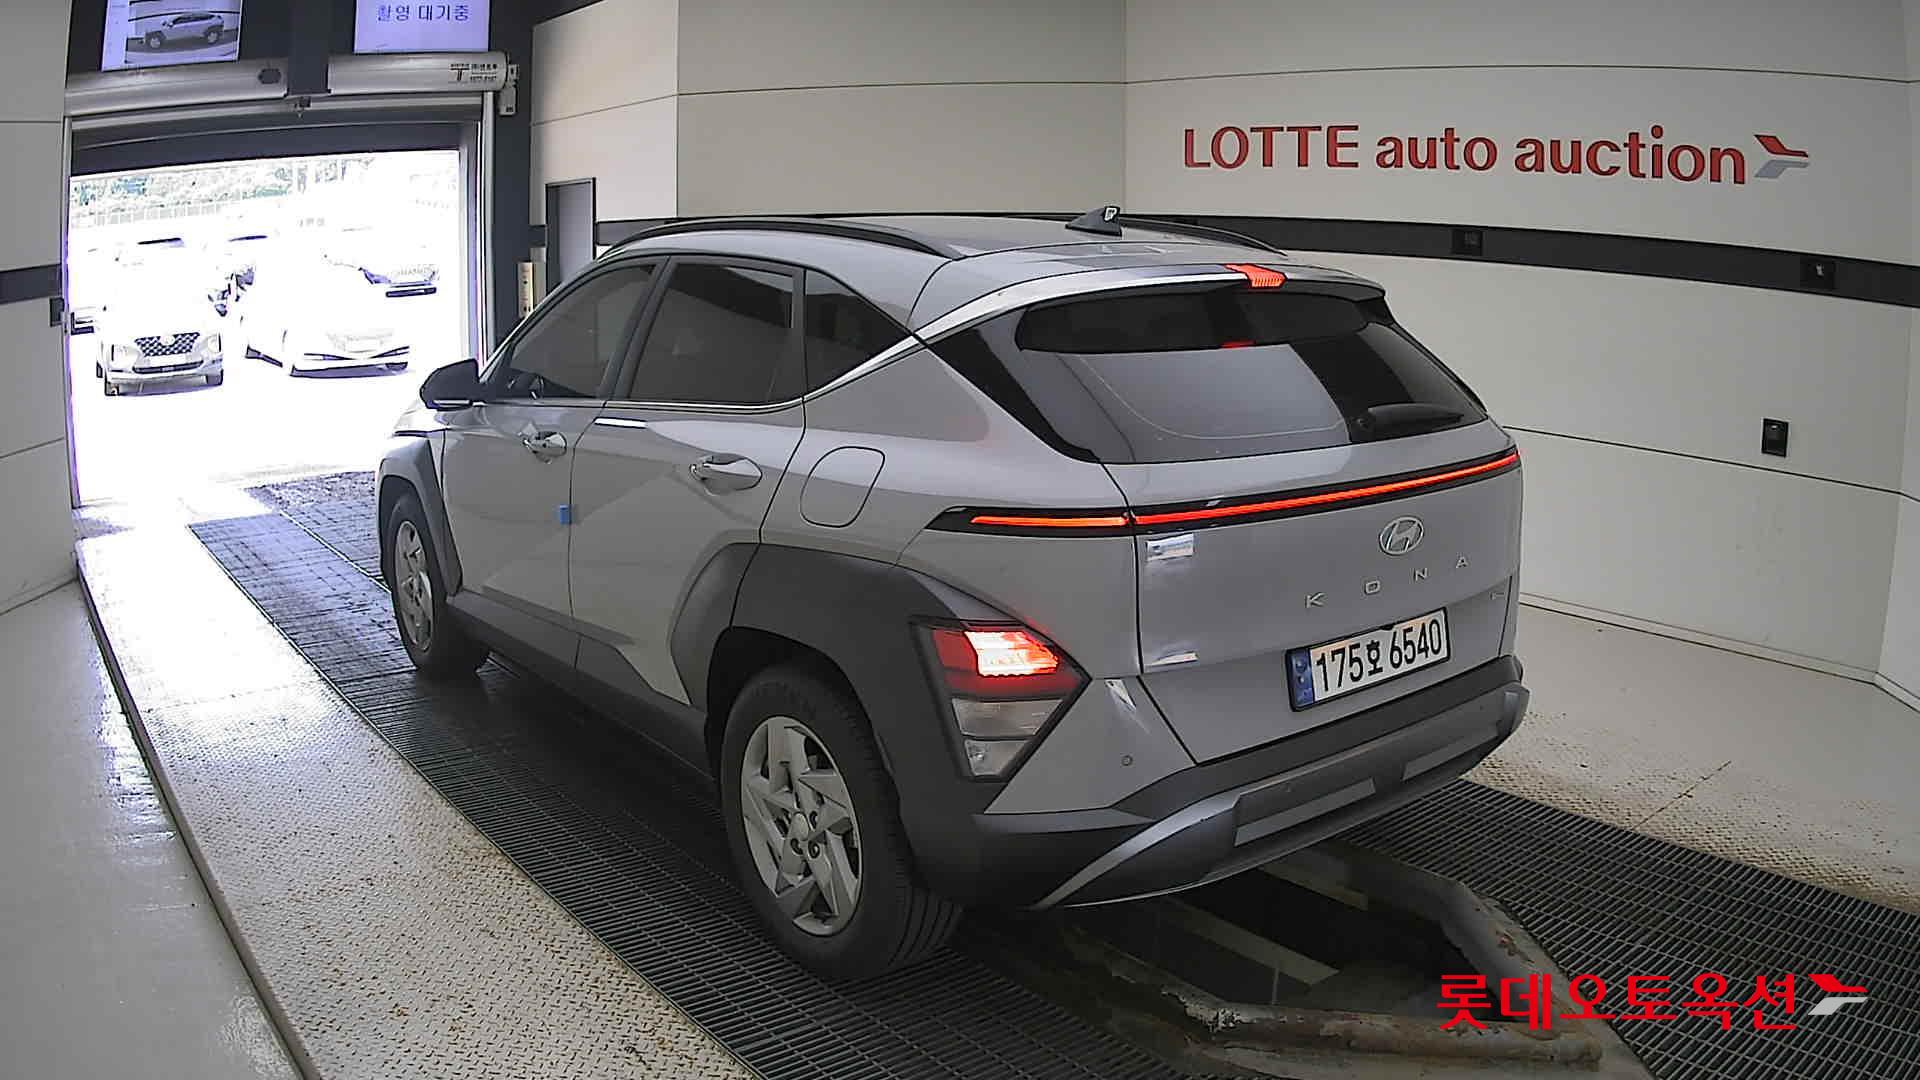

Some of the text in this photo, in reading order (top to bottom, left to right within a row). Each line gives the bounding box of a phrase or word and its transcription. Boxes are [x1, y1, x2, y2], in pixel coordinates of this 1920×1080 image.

[418, 4, 469, 22] 대기중
[1184, 125, 1747, 185] LOTTE auto auction
[1305, 556, 1469, 608] KONA
[1316, 619, 1443, 692] 175호 6540
